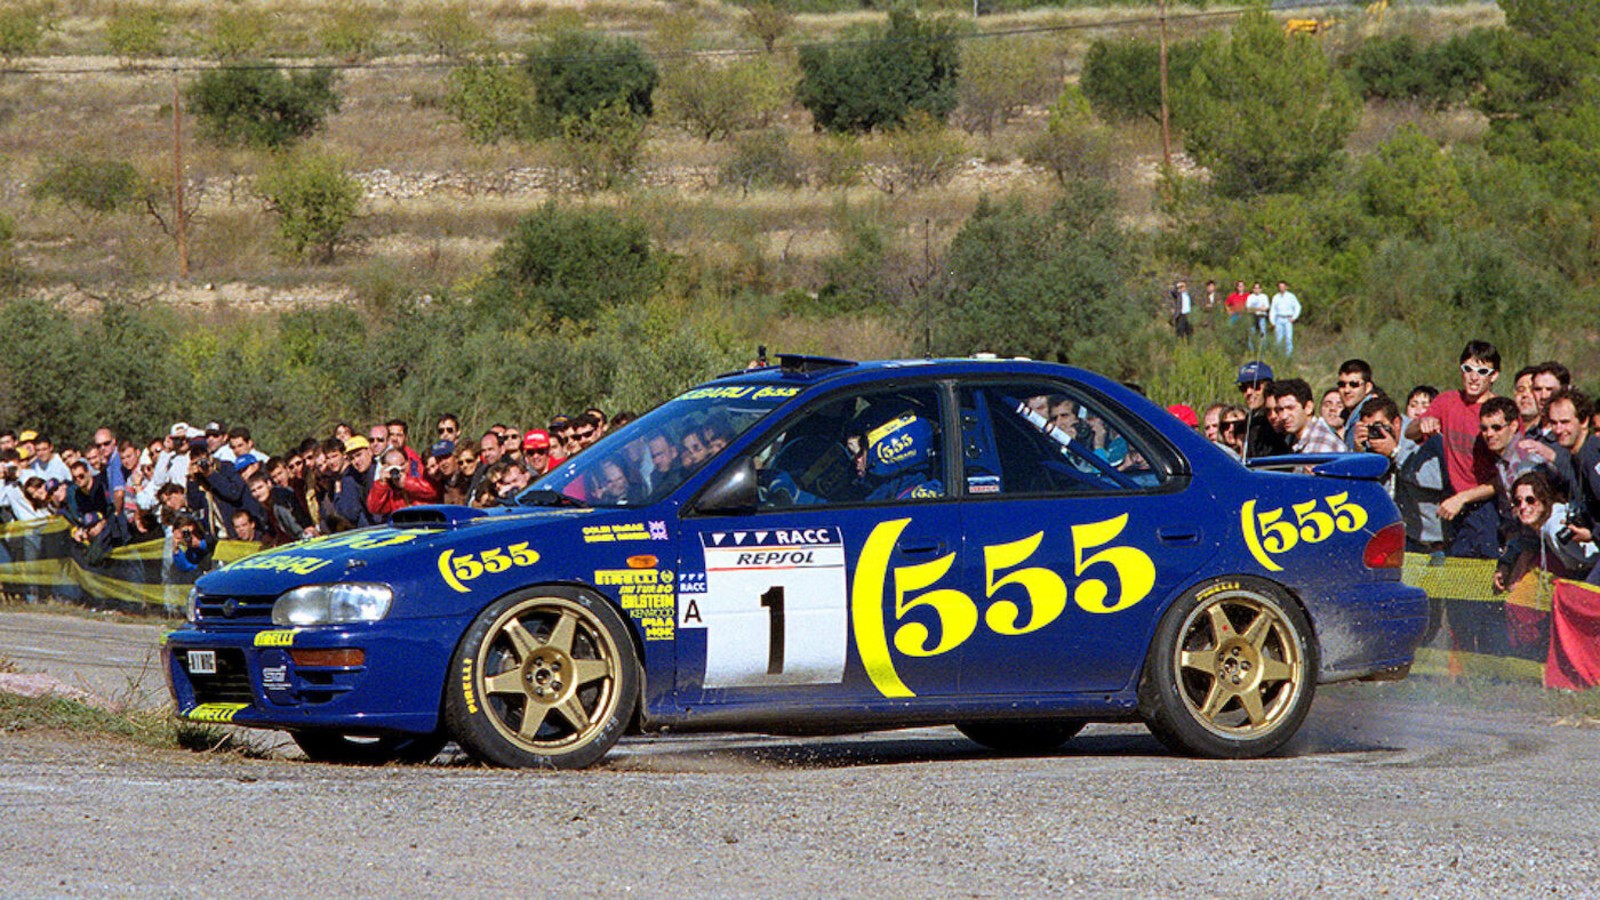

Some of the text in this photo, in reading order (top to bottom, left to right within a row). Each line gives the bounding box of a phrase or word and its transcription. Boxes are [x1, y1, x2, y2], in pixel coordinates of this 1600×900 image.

[775, 529, 831, 545] RACC
[736, 551, 815, 566] REPSOL
[594, 569, 659, 585] PIRELLI
[636, 584, 674, 594] TURBO
[679, 582, 707, 593] RACC
[621, 594, 675, 609] BILSTEIN
[630, 609, 675, 618] KENWOOD
[683, 599, 703, 623] A
[760, 586, 785, 675] 1
[462, 657, 479, 715] PIRELLI
